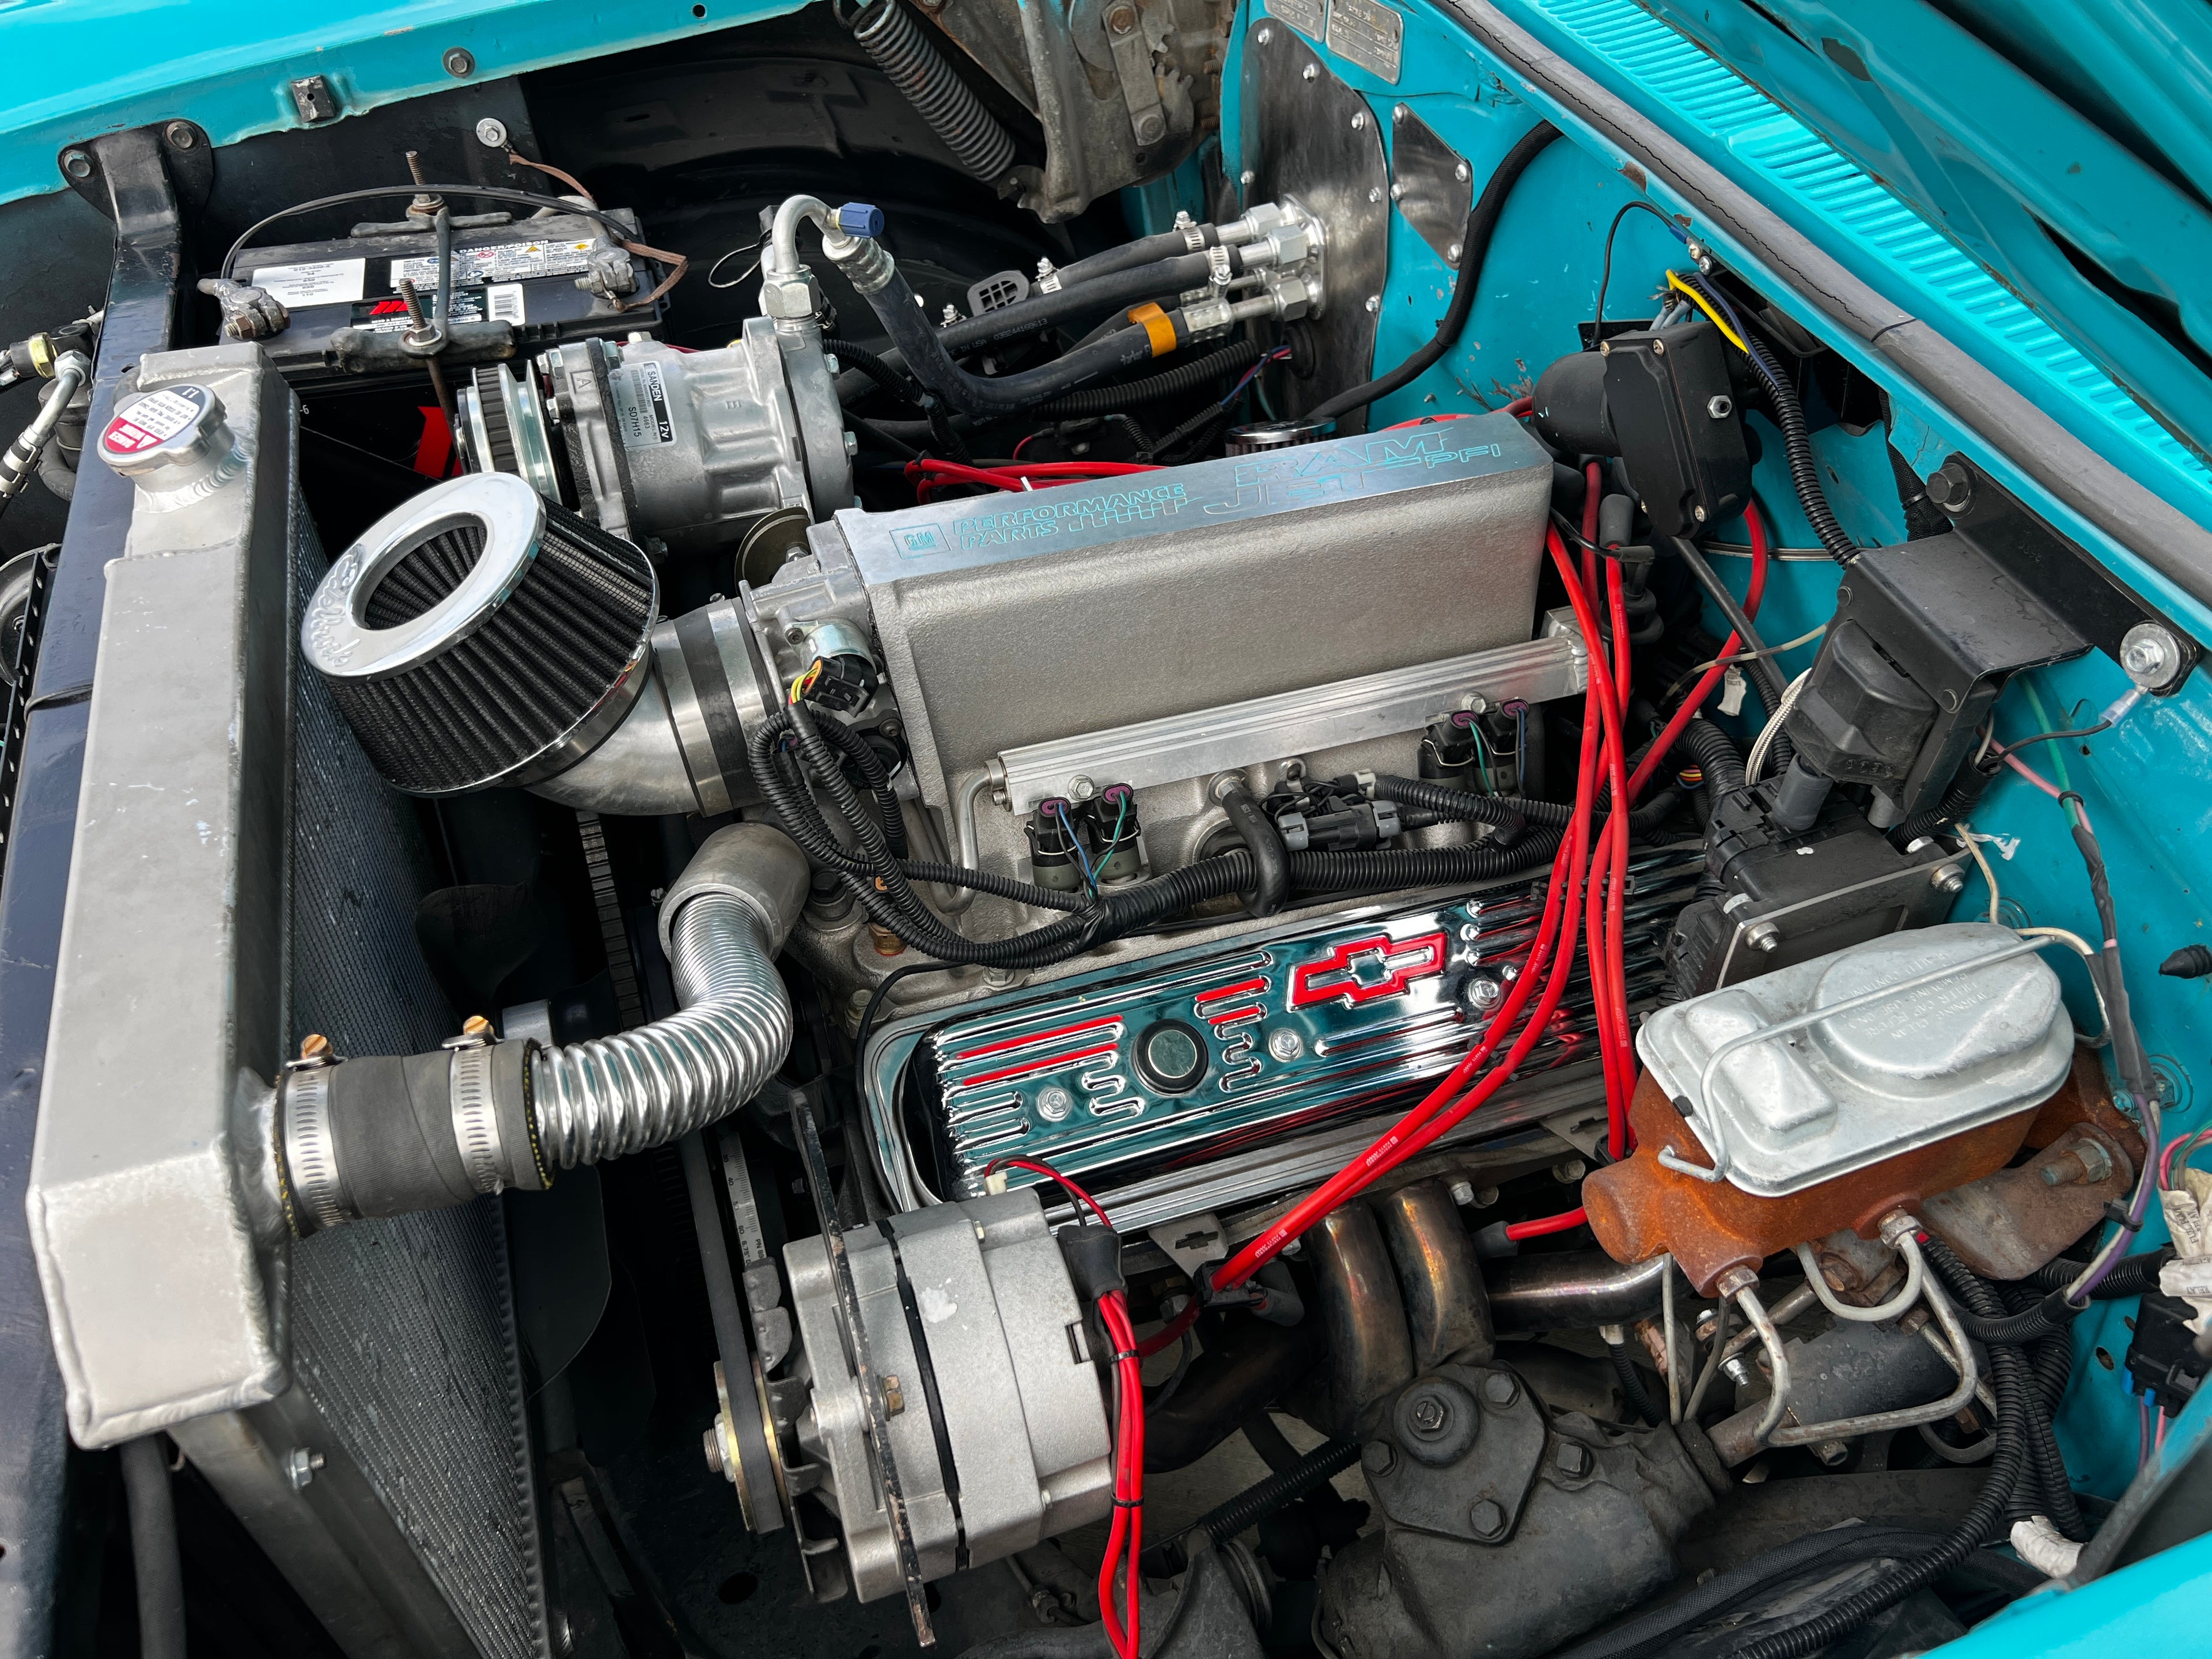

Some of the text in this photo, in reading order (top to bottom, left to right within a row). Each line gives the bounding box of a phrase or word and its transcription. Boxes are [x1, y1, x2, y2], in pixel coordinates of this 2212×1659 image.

[647, 370, 663, 402] SANDEN
[627, 406, 643, 437] SD7H15
[1425, 443, 1502, 469] PFI
[904, 483, 1187, 550] GM PERFORMANCE
[961, 520, 1059, 550] PARTS
[728, 1177, 734, 1186] 40
[738, 1225, 744, 1234] 60
[755, 1239, 762, 1249] PN
[2186, 1286, 2210, 1294] RELAY
